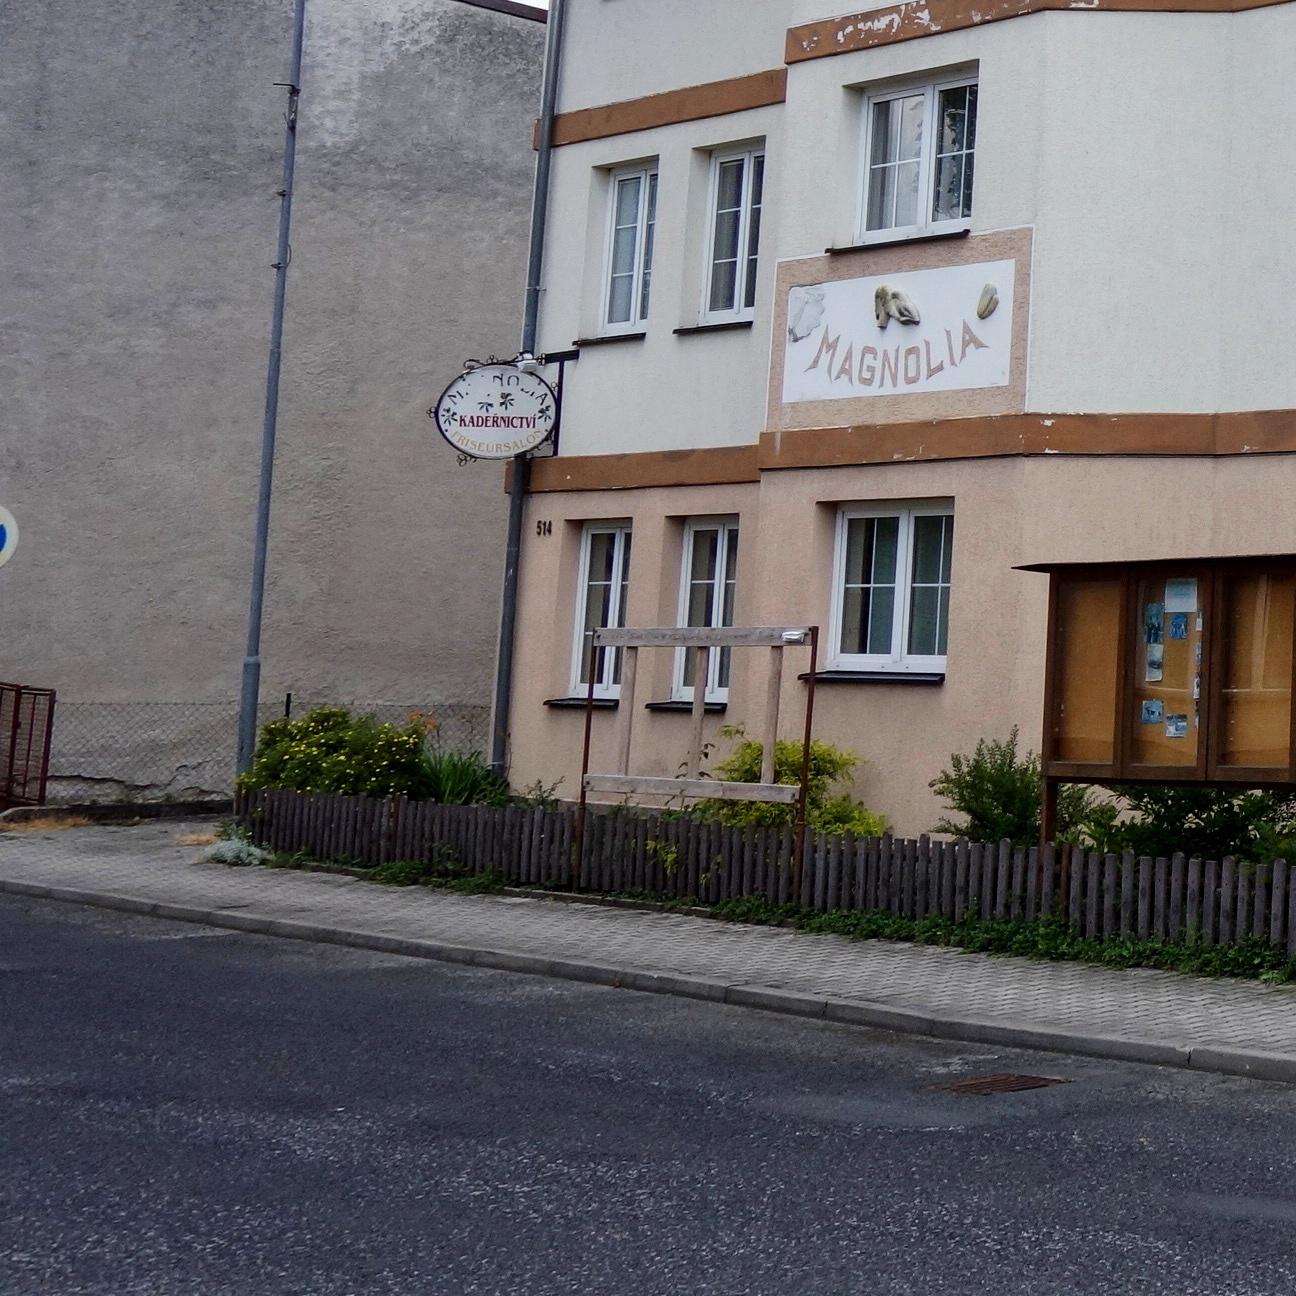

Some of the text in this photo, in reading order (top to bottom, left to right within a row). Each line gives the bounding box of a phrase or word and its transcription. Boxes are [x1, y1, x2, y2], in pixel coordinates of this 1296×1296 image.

[804, 319, 990, 389] MAGNOLIA
[459, 413, 537, 429] KADEŘNICTVÍ
[536, 520, 552, 536] 514
